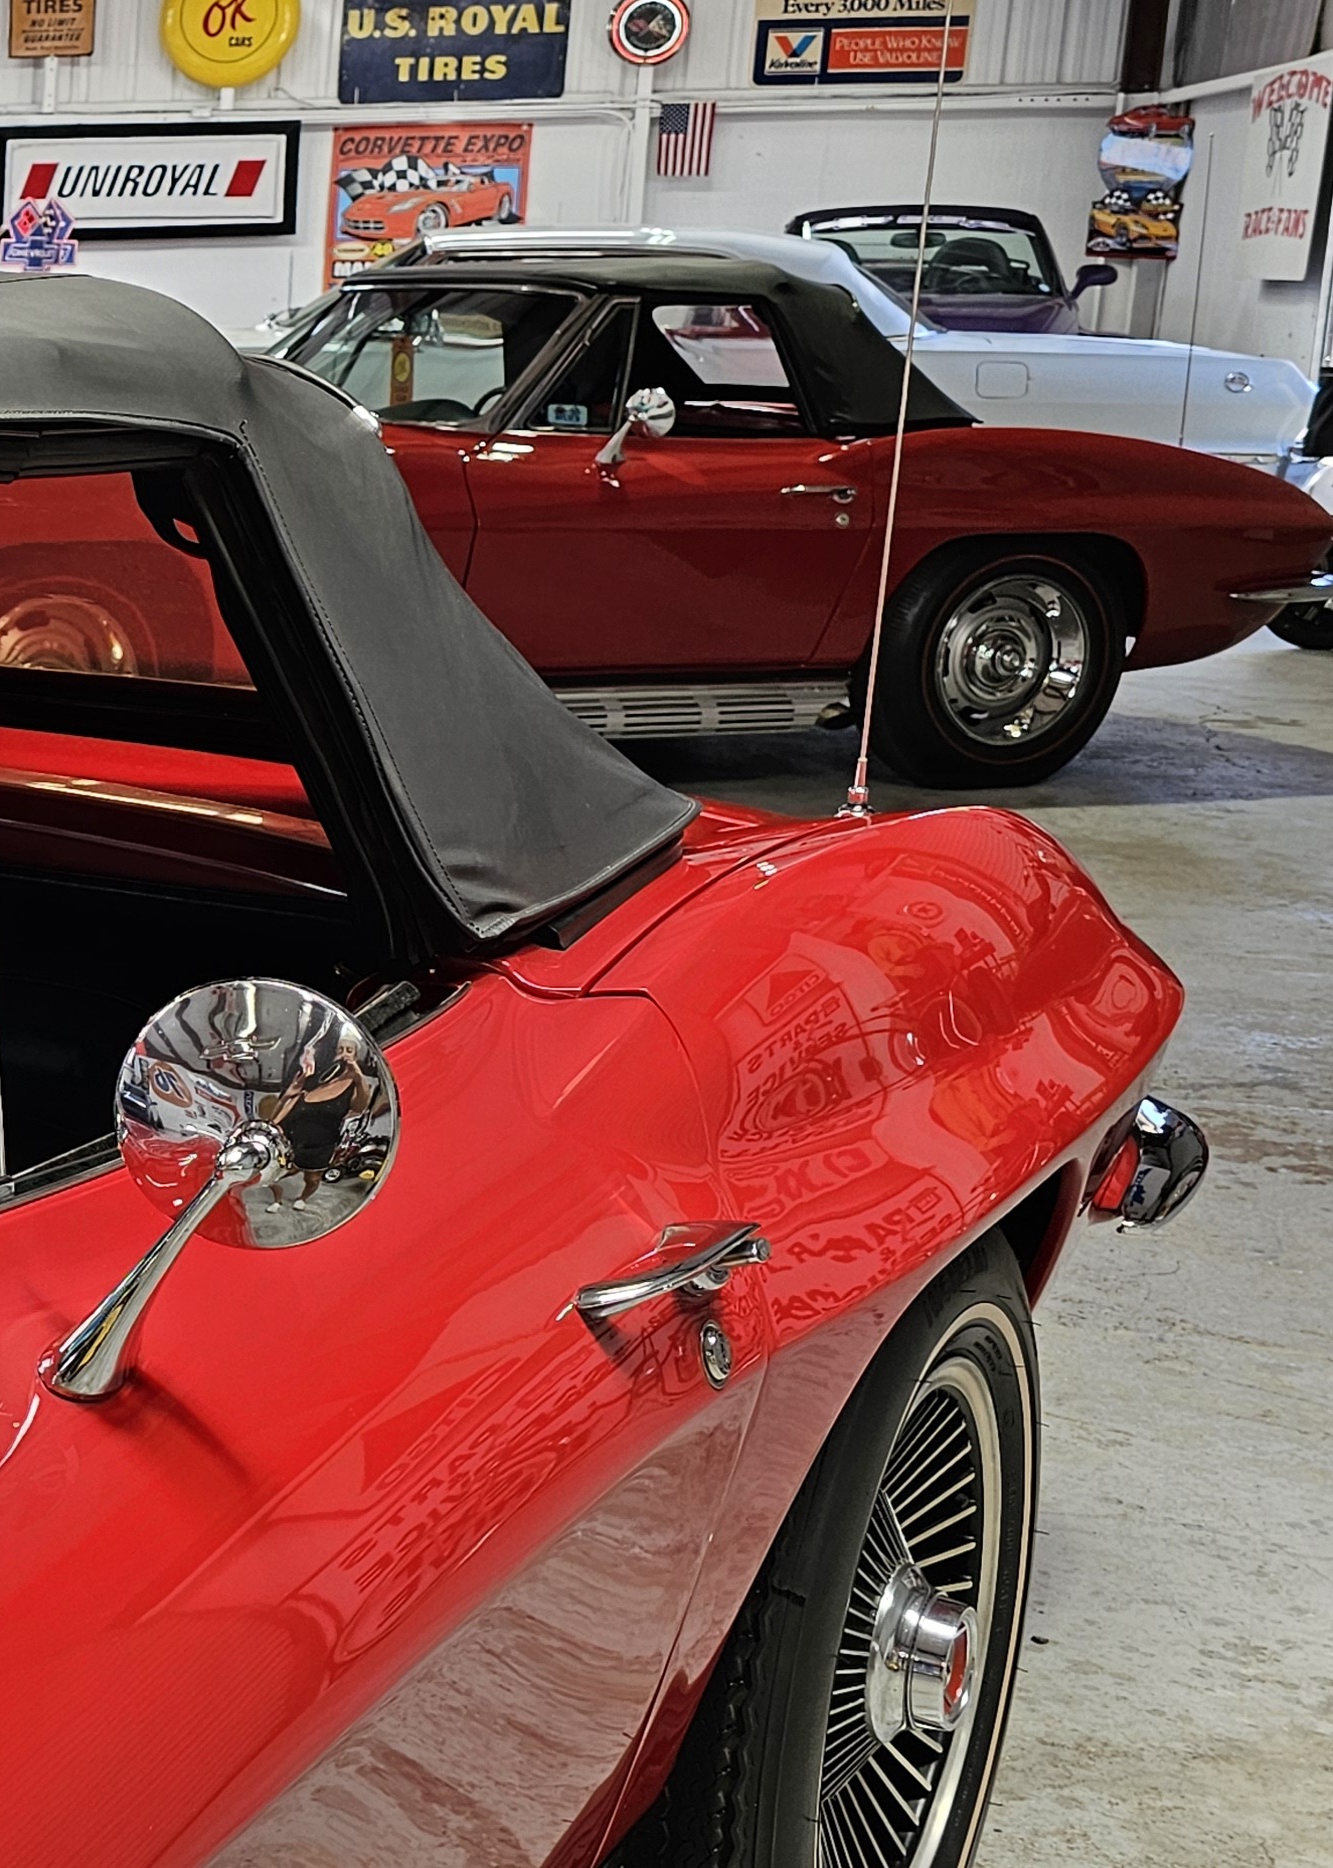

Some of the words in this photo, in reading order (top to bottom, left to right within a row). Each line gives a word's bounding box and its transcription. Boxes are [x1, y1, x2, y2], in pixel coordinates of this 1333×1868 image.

[23, 0, 83, 14] TIRES
[202, 0, 256, 37] OK
[782, 0, 833, 16] Every
[893, 0, 945, 12] Miles
[347, 8, 416, 39] U.S.
[427, 3, 566, 36] ROYAL
[835, 36, 884, 50] PEOPLE
[886, 35, 918, 49] WHO
[920, 34, 962, 49] KNW
[394, 54, 507, 82] TIRES
[850, 51, 874, 65] USE
[1251, 69, 1332, 124] WELCOME
[339, 135, 459, 155] CORVETTE
[463, 134, 525, 153] EXPO
[57, 164, 220, 198] UNIROYAL
